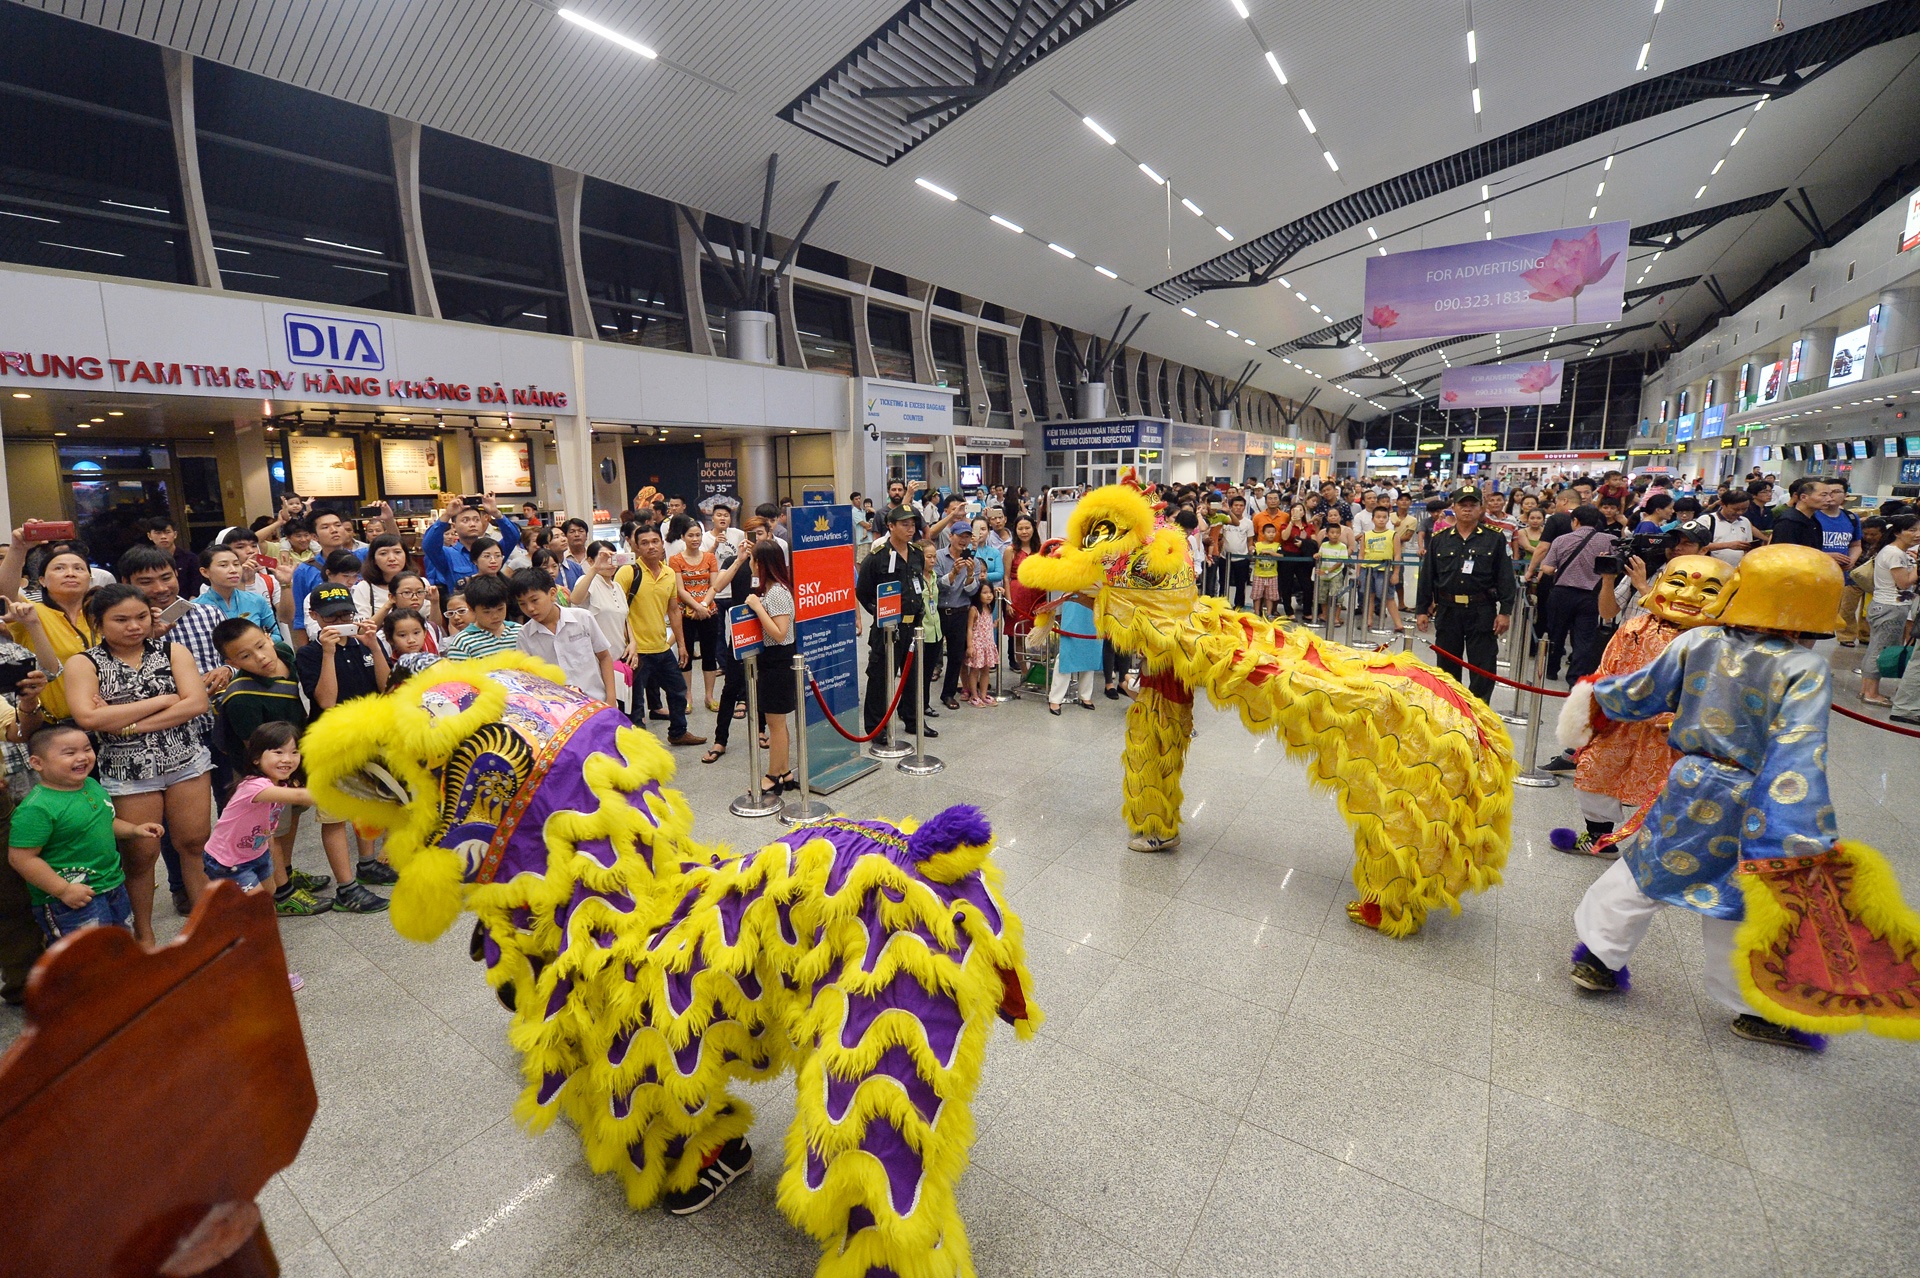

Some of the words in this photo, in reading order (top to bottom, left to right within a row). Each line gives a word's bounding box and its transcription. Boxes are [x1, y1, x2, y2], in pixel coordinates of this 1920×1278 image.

[1426, 269, 1452, 283] FOR
[1455, 256, 1545, 279] ADVERTISING
[1434, 290, 1530, 312] 090.323.1833
[288, 321, 380, 364] DIA
[0, 351, 104, 381] RUNG
[304, 369, 381, 396] HÀNG
[387, 376, 472, 401] KHÔNG
[478, 382, 508, 404] ĐÀ
[512, 384, 568, 408] NẴNG
[880, 398, 903, 408] TICKETING
[926, 403, 946, 411] BAGGAGE
[1102, 436, 1131, 444] INSPECTION
[1822, 531, 1852, 546] LIZZARD
[798, 581, 821, 596] SKY
[798, 588, 850, 609] PRIORITY
